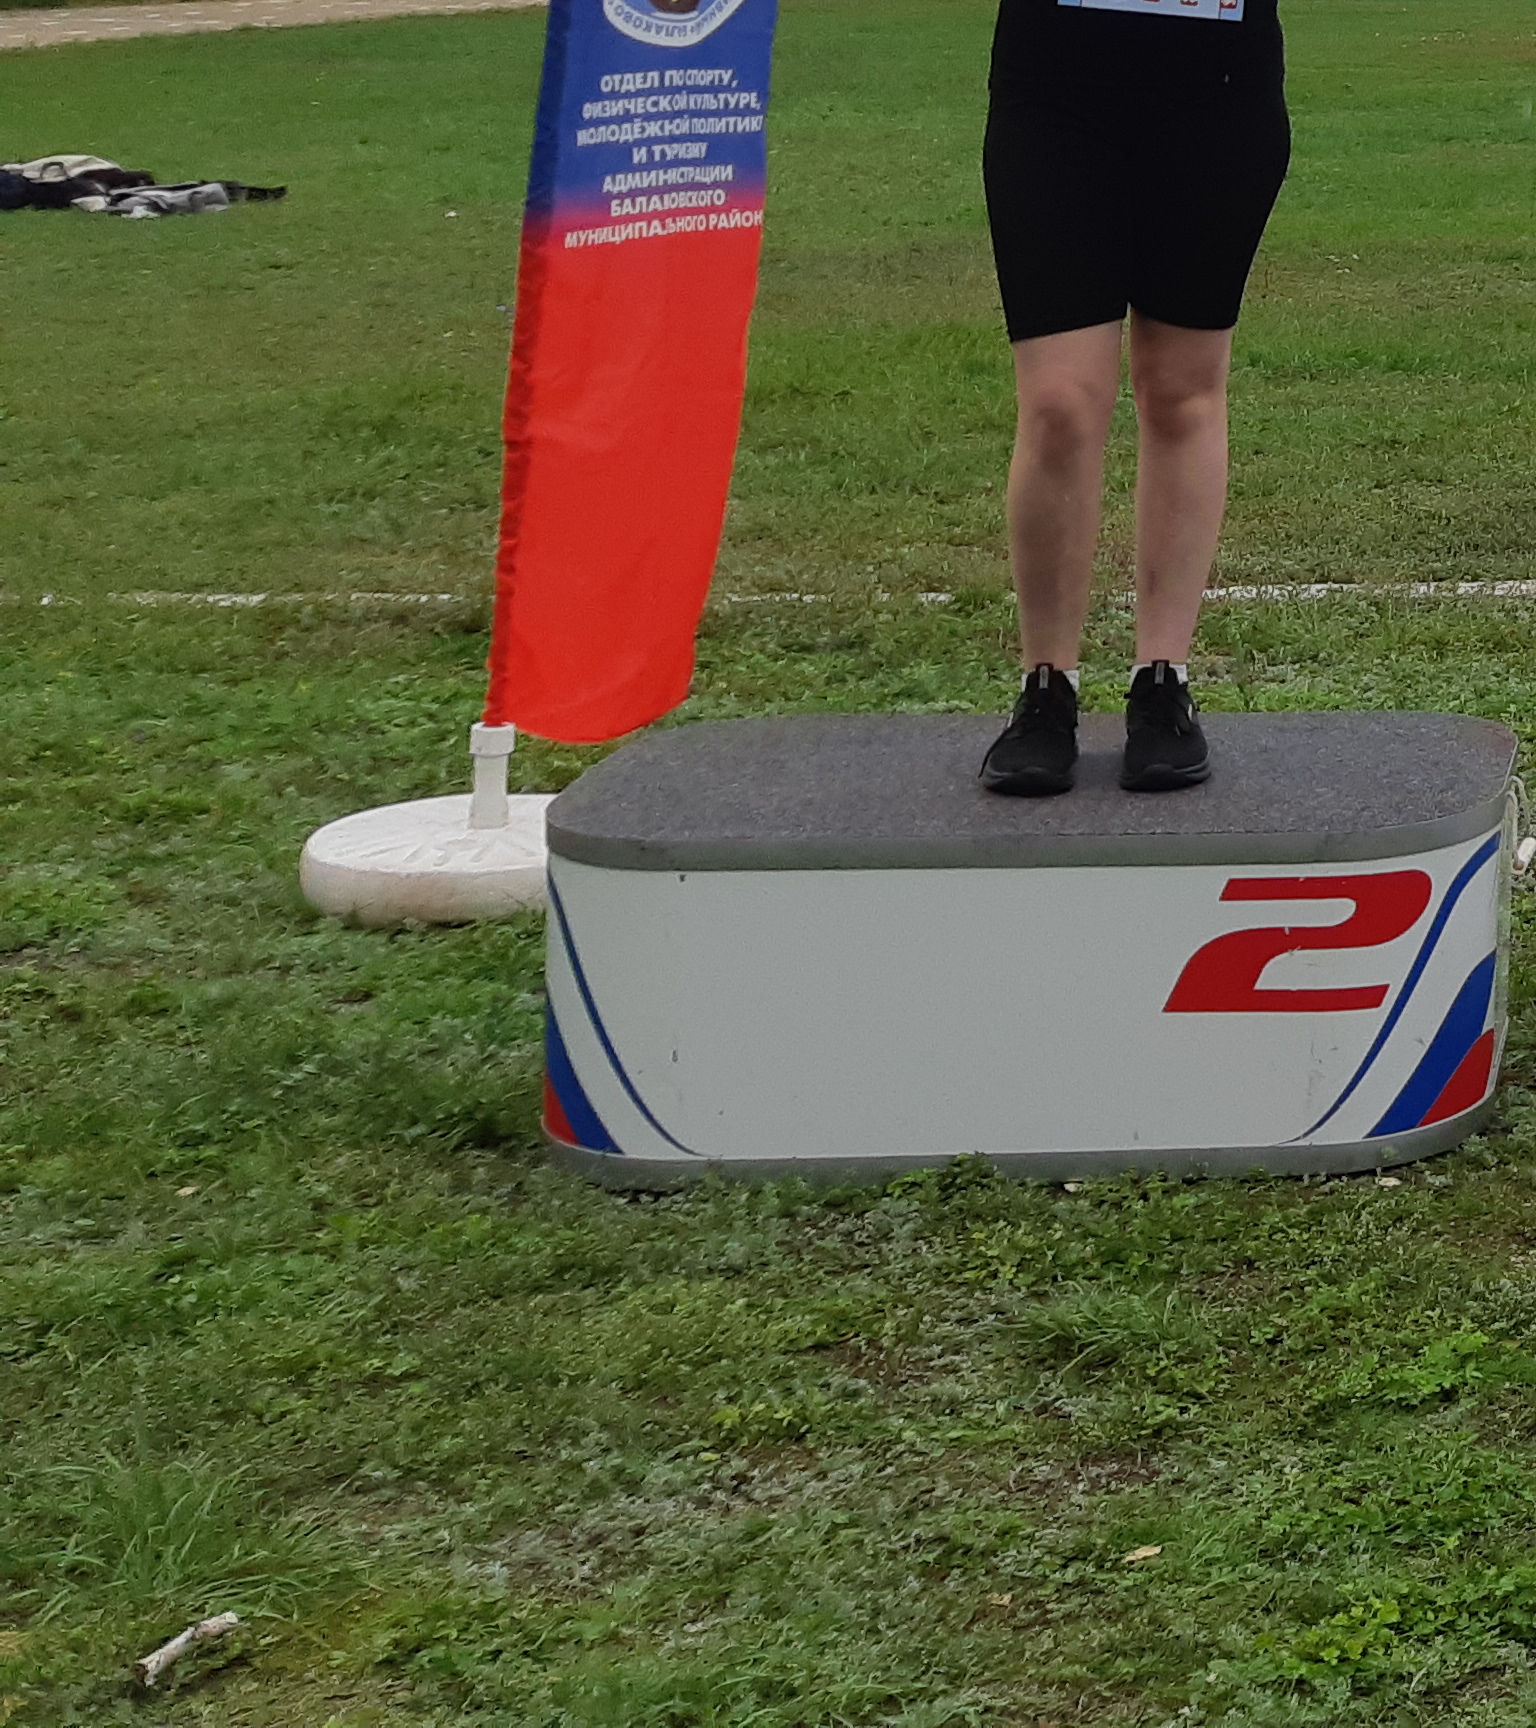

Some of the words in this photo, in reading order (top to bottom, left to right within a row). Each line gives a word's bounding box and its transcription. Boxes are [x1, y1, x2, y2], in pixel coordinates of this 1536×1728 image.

[600, 71, 659, 93] ОТДЕЛ
[664, 70, 684, 88] ПО
[582, 91, 688, 120] ФИЗИЧЕСКОЙ
[632, 147, 647, 164] И
[709, 208, 764, 229] РАЙОН
[1161, 869, 1432, 1012] 2
